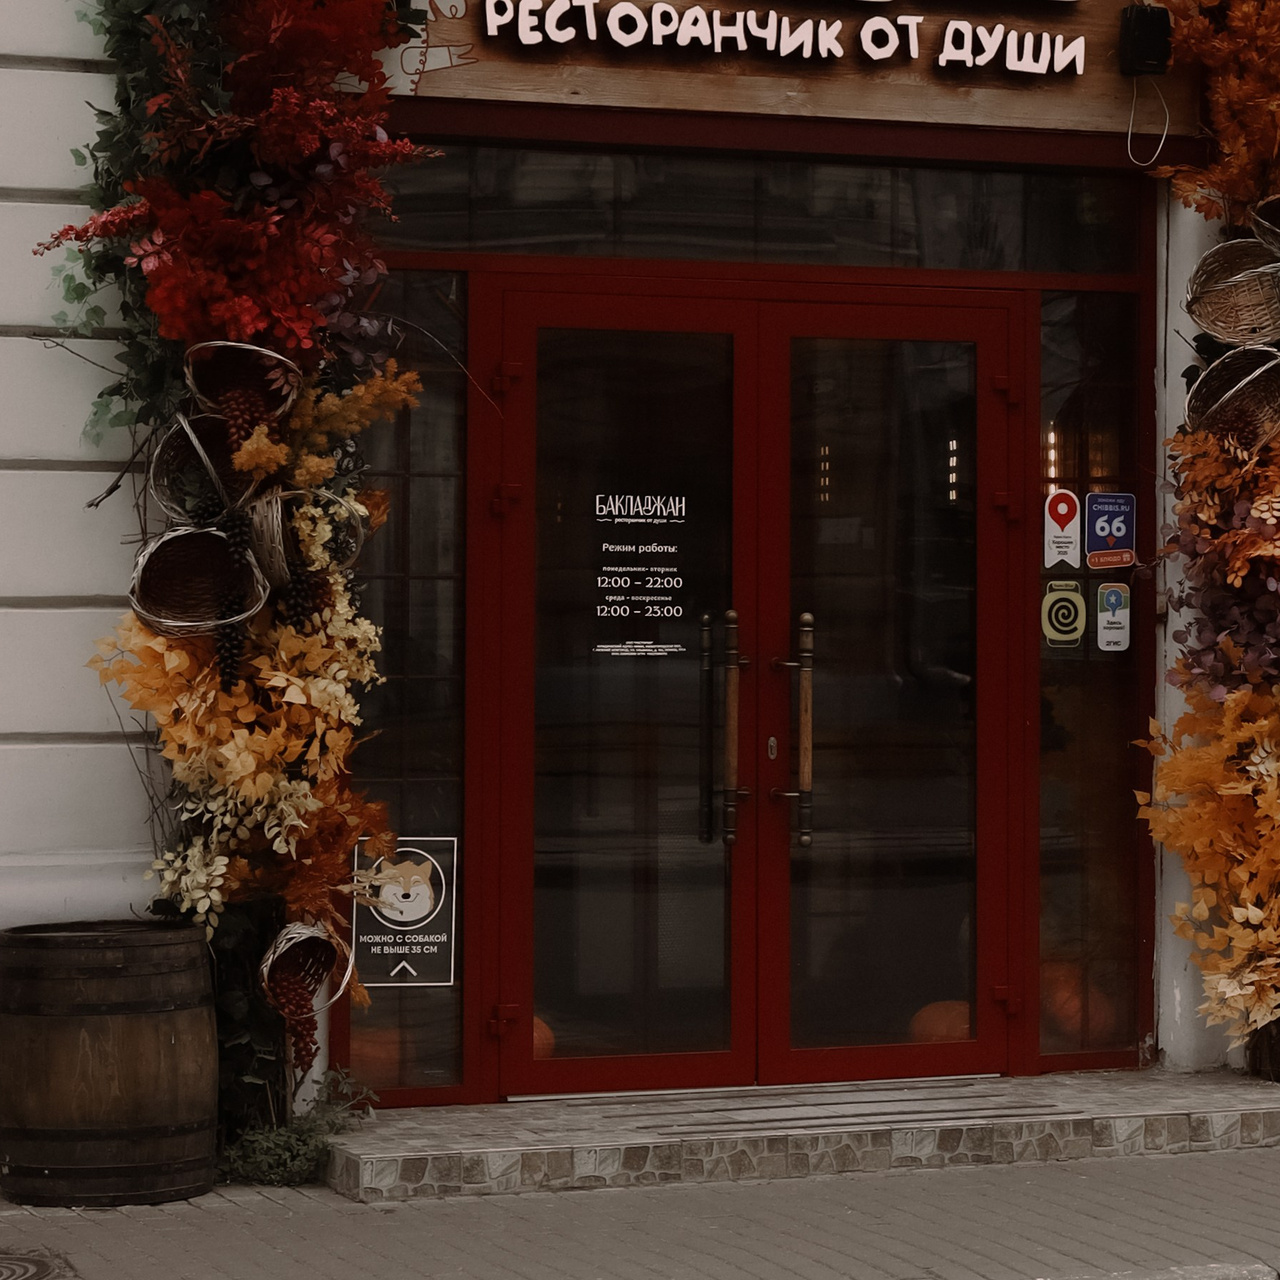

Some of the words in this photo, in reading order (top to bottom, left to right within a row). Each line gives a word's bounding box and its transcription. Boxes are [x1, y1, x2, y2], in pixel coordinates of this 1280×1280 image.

[485, 0, 844, 58] РЕСТОРАНЧИК
[860, 15, 924, 60] ОТ
[938, 20, 1086, 75] ДУШИ
[595, 494, 686, 517] БАКЛАДЖАН
[602, 543, 636, 552] Режим
[638, 543, 678, 554] работы:
[596, 576, 631, 588] 12:00
[645, 576, 683, 588] 22:00
[605, 595, 625, 603] среда
[596, 605, 630, 617] 12:00
[644, 605, 683, 617] 23:00
[359, 934, 395, 943] МОЖНО
[396, 934, 403, 943] С
[404, 932, 448, 943] СОБАКОЙ
[370, 946, 382, 954] НЕ
[383, 946, 410, 954] ВЫШЕ
[411, 946, 422, 954] 35
[423, 945, 438, 954] СМ
